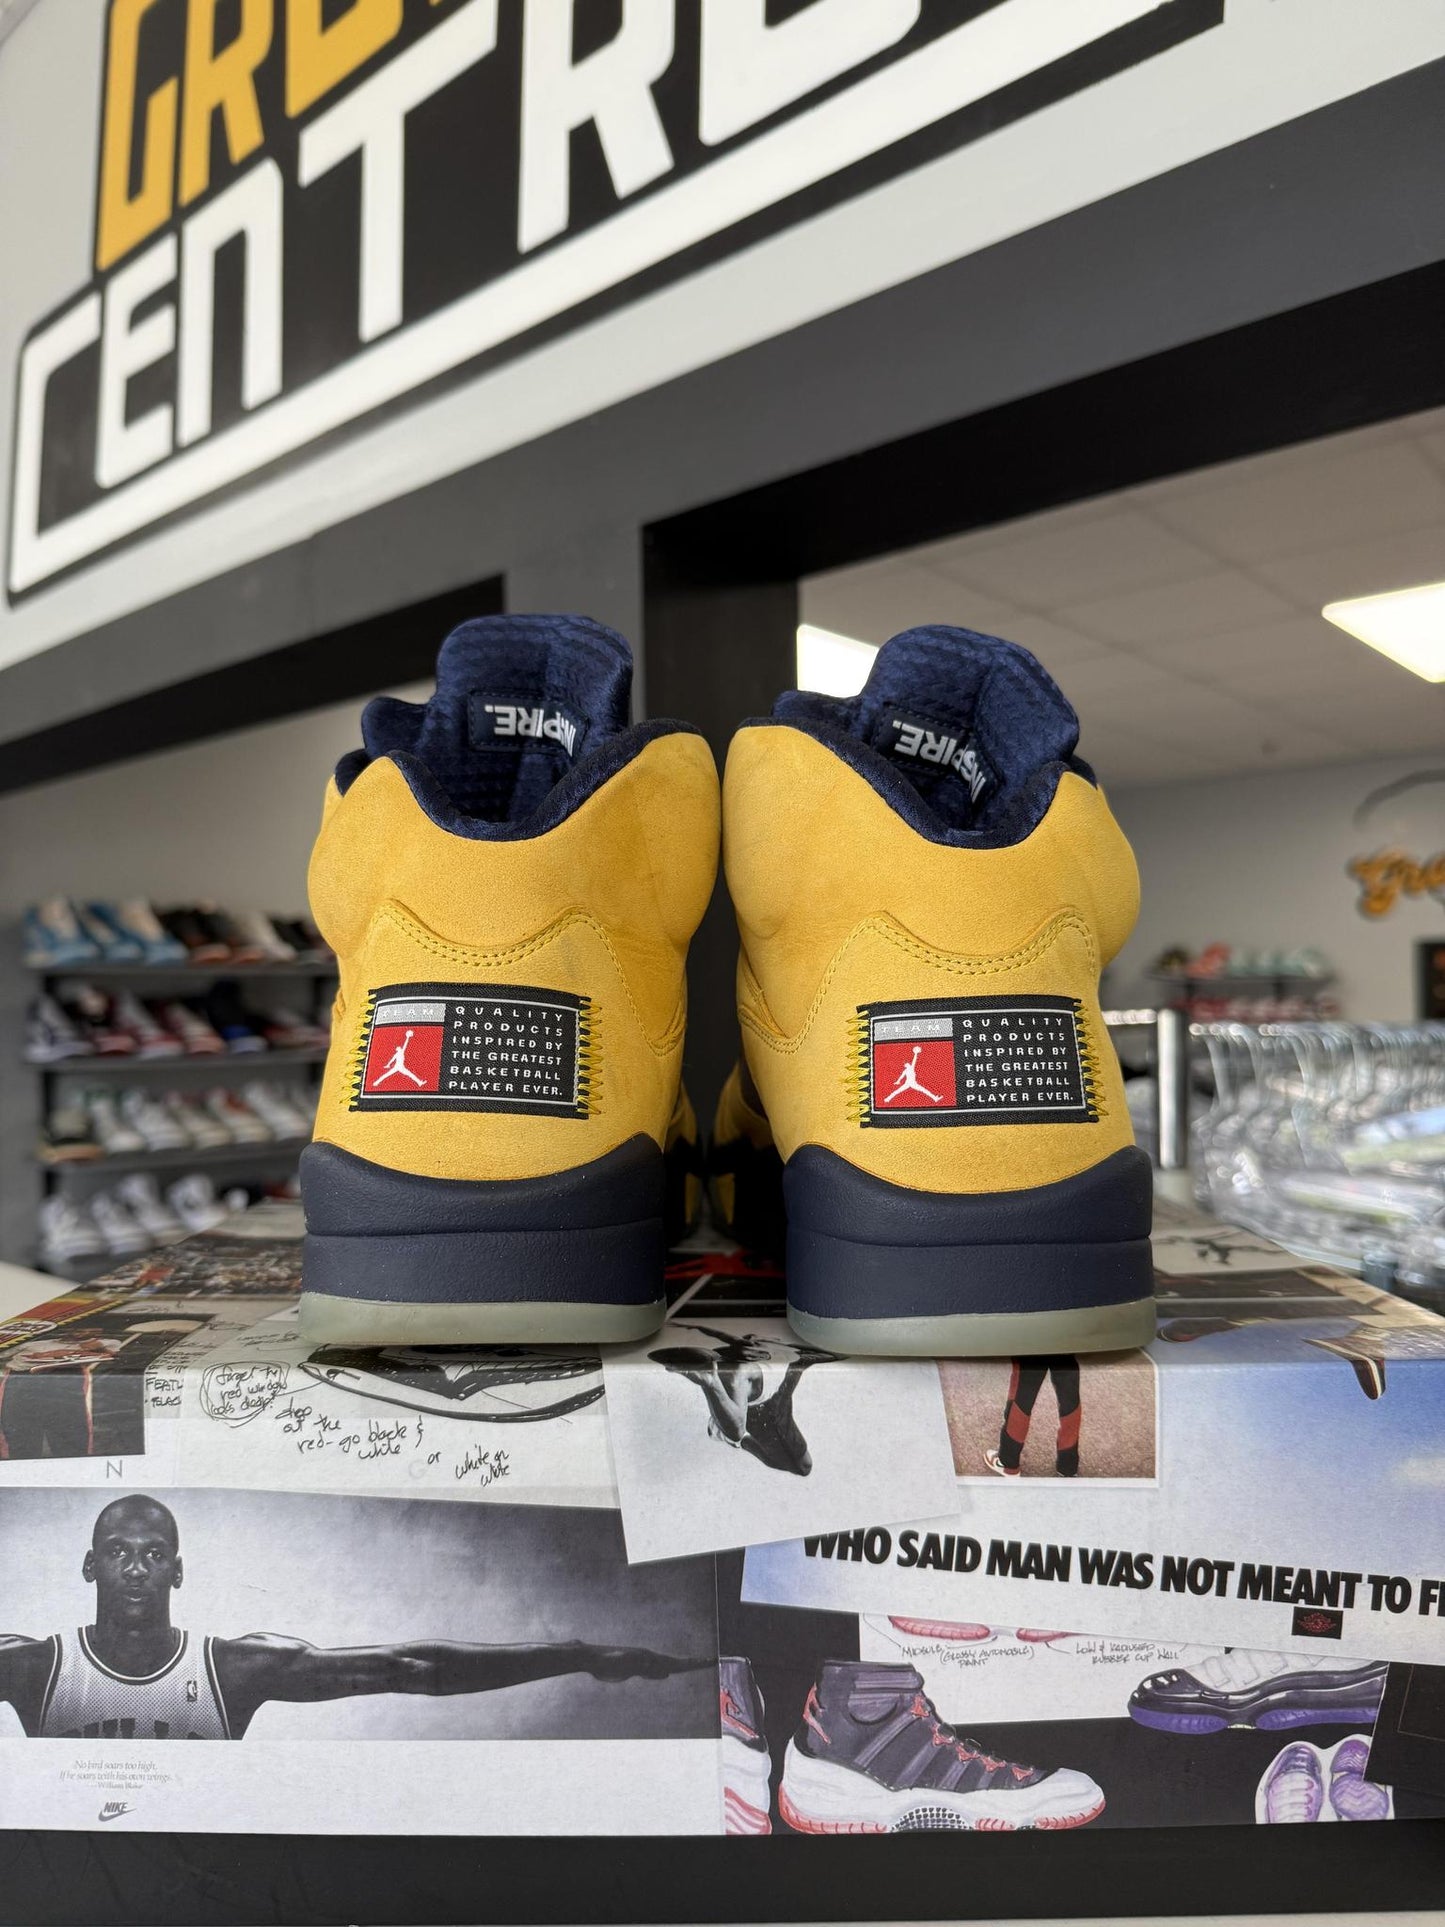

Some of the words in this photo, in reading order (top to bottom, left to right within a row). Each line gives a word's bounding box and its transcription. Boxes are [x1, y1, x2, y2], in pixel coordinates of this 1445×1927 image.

[382, 1007, 435, 1019] TEAM
[455, 1006, 563, 1022] QUALITY
[453, 1020, 563, 1037] PRODUCTS
[881, 1023, 941, 1033] TEAM
[962, 1017, 1062, 1029] QUALITY
[452, 1035, 537, 1049] INSPIRED
[545, 1041, 563, 1051] BY
[963, 1032, 1065, 1043] PRODUCTS
[451, 1050, 481, 1060] THE
[487, 1052, 562, 1066] GREATEST
[964, 1046, 1044, 1058] INSPIRED
[1052, 1047, 1067, 1056] BY
[450, 1065, 561, 1081] BASKETBALL
[965, 1062, 994, 1072] THE
[1001, 1061, 1068, 1072] GREATEST
[448, 1080, 514, 1092] PLAYER
[522, 1084, 563, 1096] EVER.
[966, 1076, 1070, 1088] BASKETBALL
[967, 1092, 1030, 1103] PLAYER
[1037, 1091, 1074, 1101] EVER.
[427, 1451, 442, 1465] or
[106, 1460, 123, 1478] N
[803, 1527, 892, 1565] WHO
[898, 1529, 982, 1572] SAID
[986, 1539, 1072, 1583] MAN
[1078, 1547, 1154, 1590] WAS
[1161, 1554, 1236, 1598] NOT
[1238, 1562, 1362, 1609] MEANT
[1367, 1574, 1413, 1614] TO
[104, 1802, 128, 1812] NIKE
